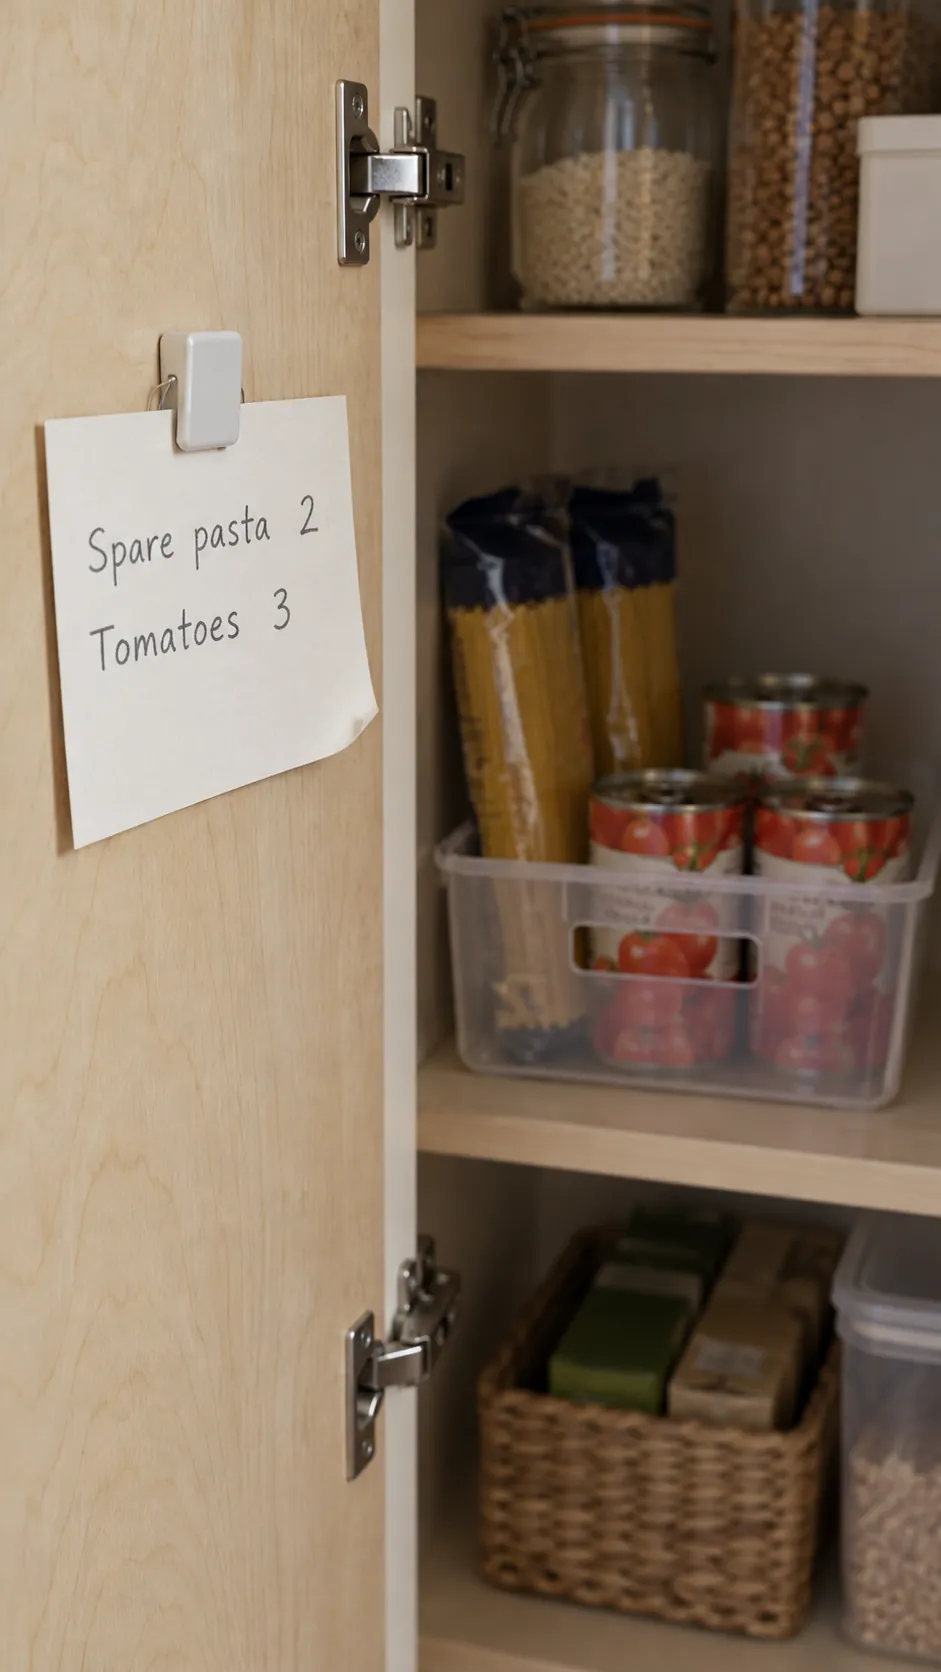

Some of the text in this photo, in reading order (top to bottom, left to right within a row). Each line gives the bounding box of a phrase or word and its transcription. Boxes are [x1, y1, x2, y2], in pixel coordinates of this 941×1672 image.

[88, 494, 319, 587] Spare pasta 2
[89, 587, 291, 672] Tomatoes 3
